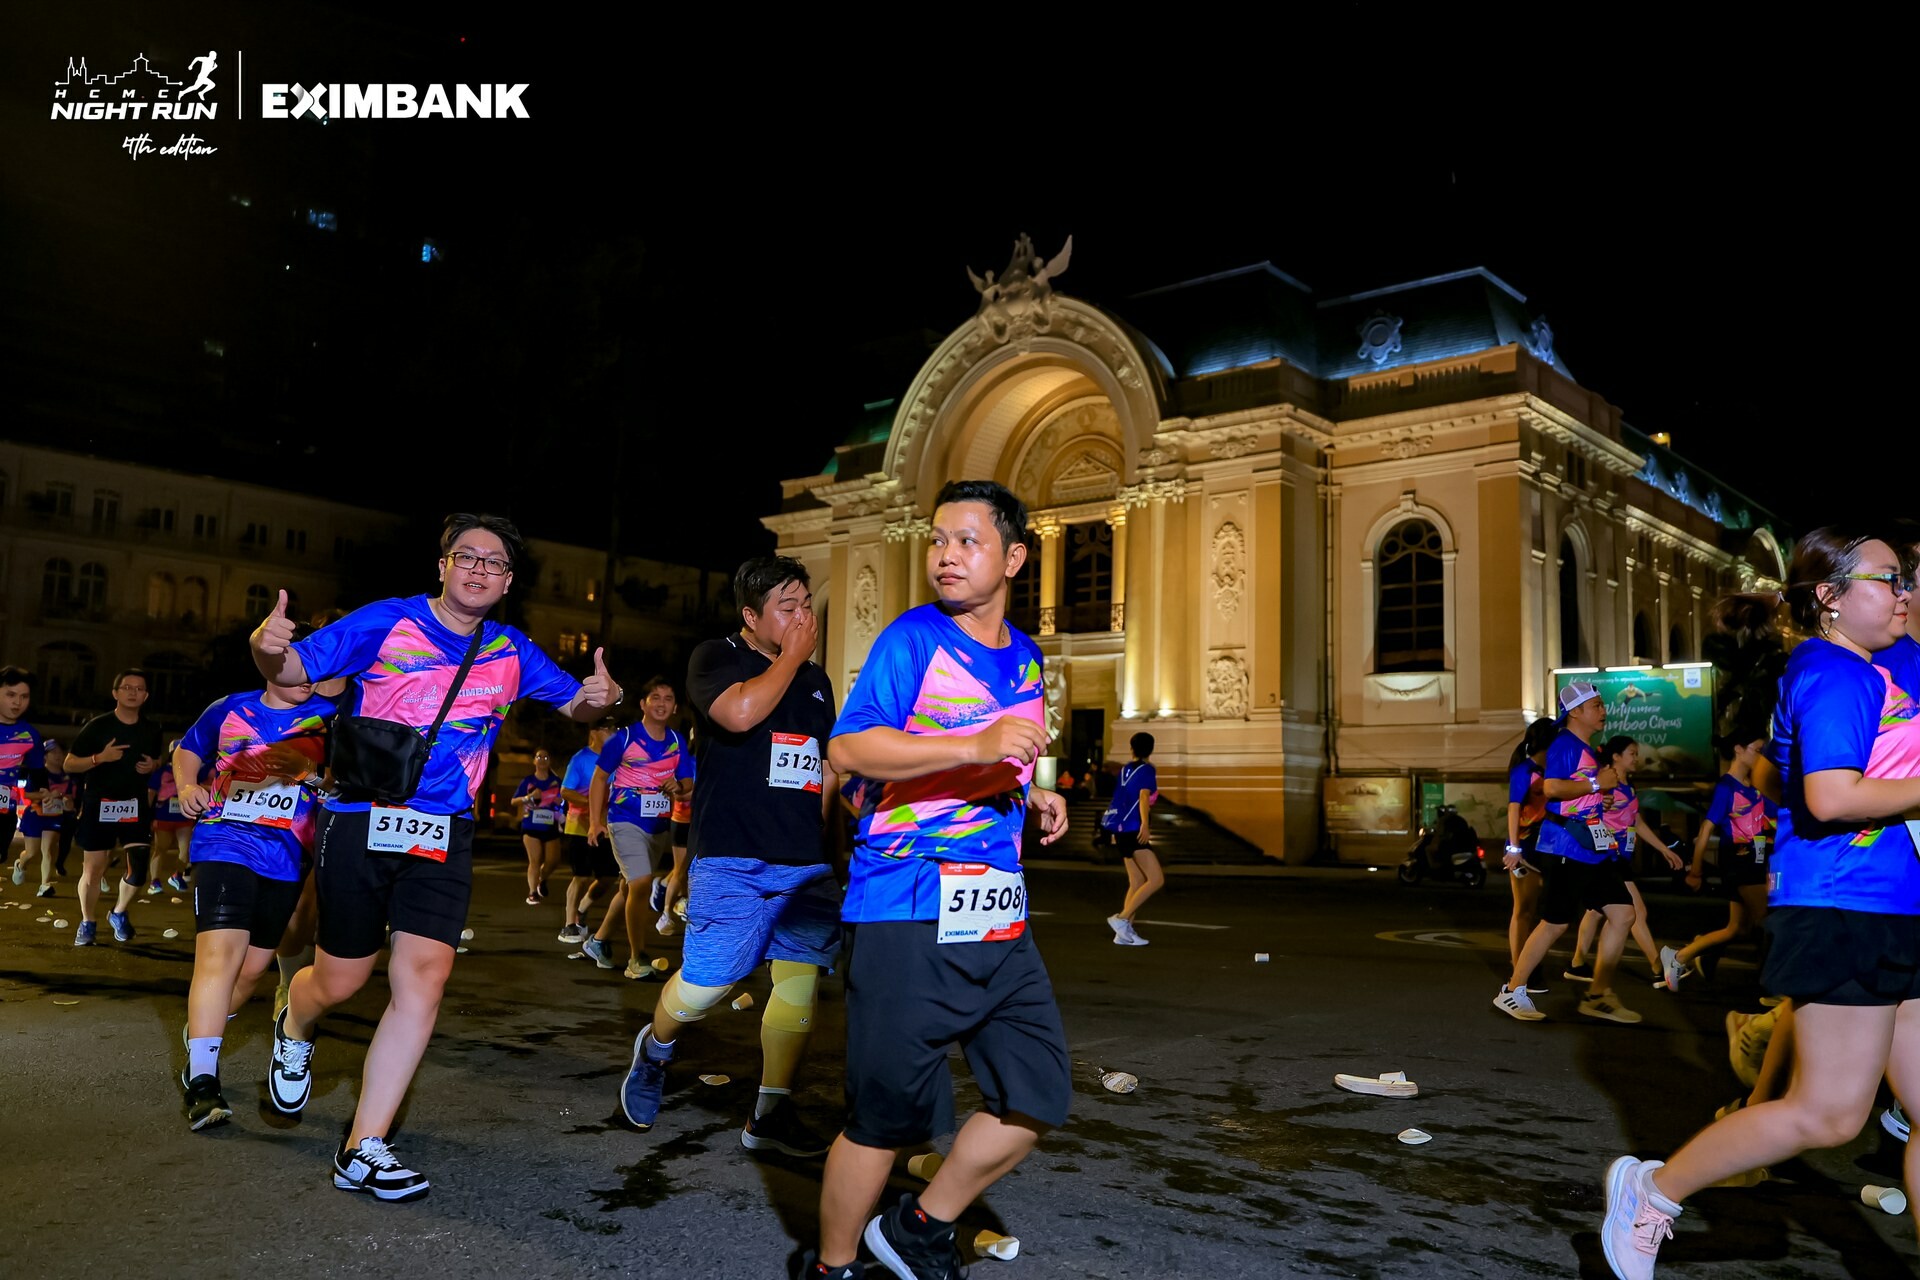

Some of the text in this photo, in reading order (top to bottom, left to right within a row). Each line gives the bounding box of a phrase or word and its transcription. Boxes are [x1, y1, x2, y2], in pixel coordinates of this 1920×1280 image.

[103, 805, 135, 814] 51041
[231, 788, 293, 810] 51500
[644, 800, 668, 809] 51557
[376, 816, 445, 840] 51375
[948, 885, 1021, 912] 51508
